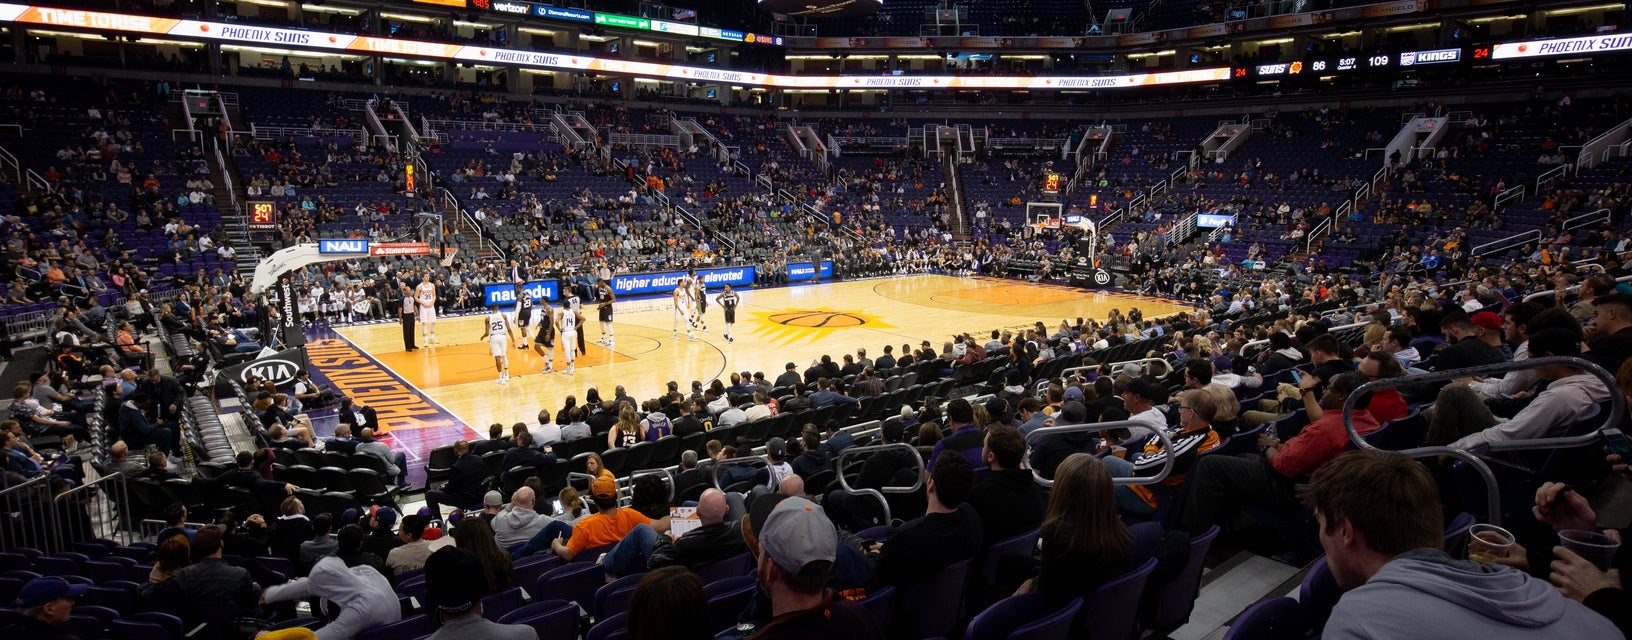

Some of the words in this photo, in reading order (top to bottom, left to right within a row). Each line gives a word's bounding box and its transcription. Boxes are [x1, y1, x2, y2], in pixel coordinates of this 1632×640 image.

[494, 2, 526, 14] verizon
[37, 8, 85, 25] TIME
[86, 13, 109, 28] TO
[110, 16, 151, 32] RISE
[221, 26, 271, 41] PHOENIX
[274, 31, 310, 44] SUNS
[1538, 37, 1597, 55] PHOENIX
[494, 51, 530, 63] PHOENIX
[532, 55, 559, 66] SUNS
[1417, 51, 1457, 62] KINGS
[1474, 48, 1489, 58] 24
[1312, 60, 1326, 70] 86
[1339, 58, 1356, 66] 5:07
[1368, 56, 1389, 66] 109
[1235, 68, 1246, 77] 24
[1258, 63, 1286, 75] SUNS
[693, 69, 721, 80] PHOENIX
[722, 72, 742, 82] SUNS
[866, 78, 897, 86] PHOENIX
[898, 78, 922, 86] SUNS
[1058, 78, 1091, 87] PHOENIX
[1091, 78, 1117, 87] SUNS
[1046, 180, 1057, 189] 24
[254, 212, 269, 222] 24
[326, 241, 362, 251] NAU
[616, 277, 650, 291] higher
[704, 269, 744, 283] elevated
[1097, 274, 1108, 282] KIA
[282, 284, 294, 328] Southwest
[491, 320, 504, 331] 25
[565, 317, 573, 327] 14
[304, 338, 370, 367] SUNS
[250, 364, 291, 382] KIA
[319, 364, 456, 433] PHOENIX
